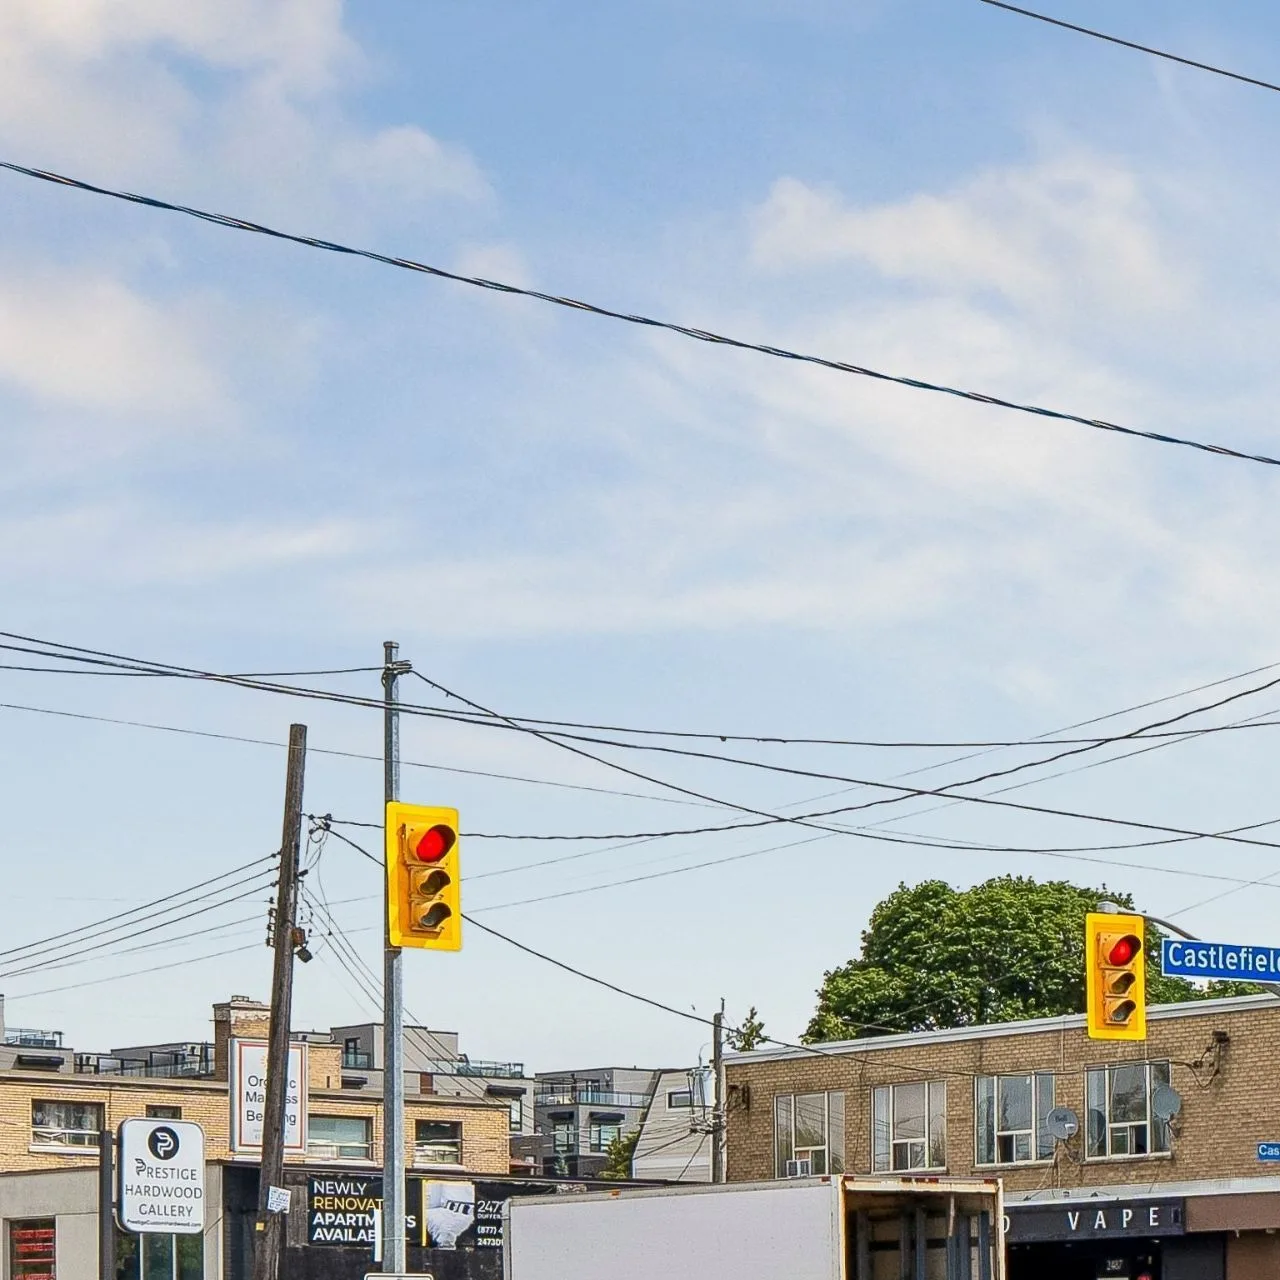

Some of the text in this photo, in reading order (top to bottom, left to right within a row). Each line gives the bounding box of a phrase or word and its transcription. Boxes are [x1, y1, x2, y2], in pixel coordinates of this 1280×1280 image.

[245, 1091, 298, 1105] Mass
[246, 1110, 297, 1126] Beng
[135, 1158, 197, 1181] PRESTIGE
[125, 1184, 203, 1199] HARDWOOD
[313, 1181, 367, 1195] NEWLY
[139, 1203, 194, 1217] GALLERY
[313, 1197, 384, 1211] RENOVAT
[1067, 1207, 1160, 1231] VAPE
